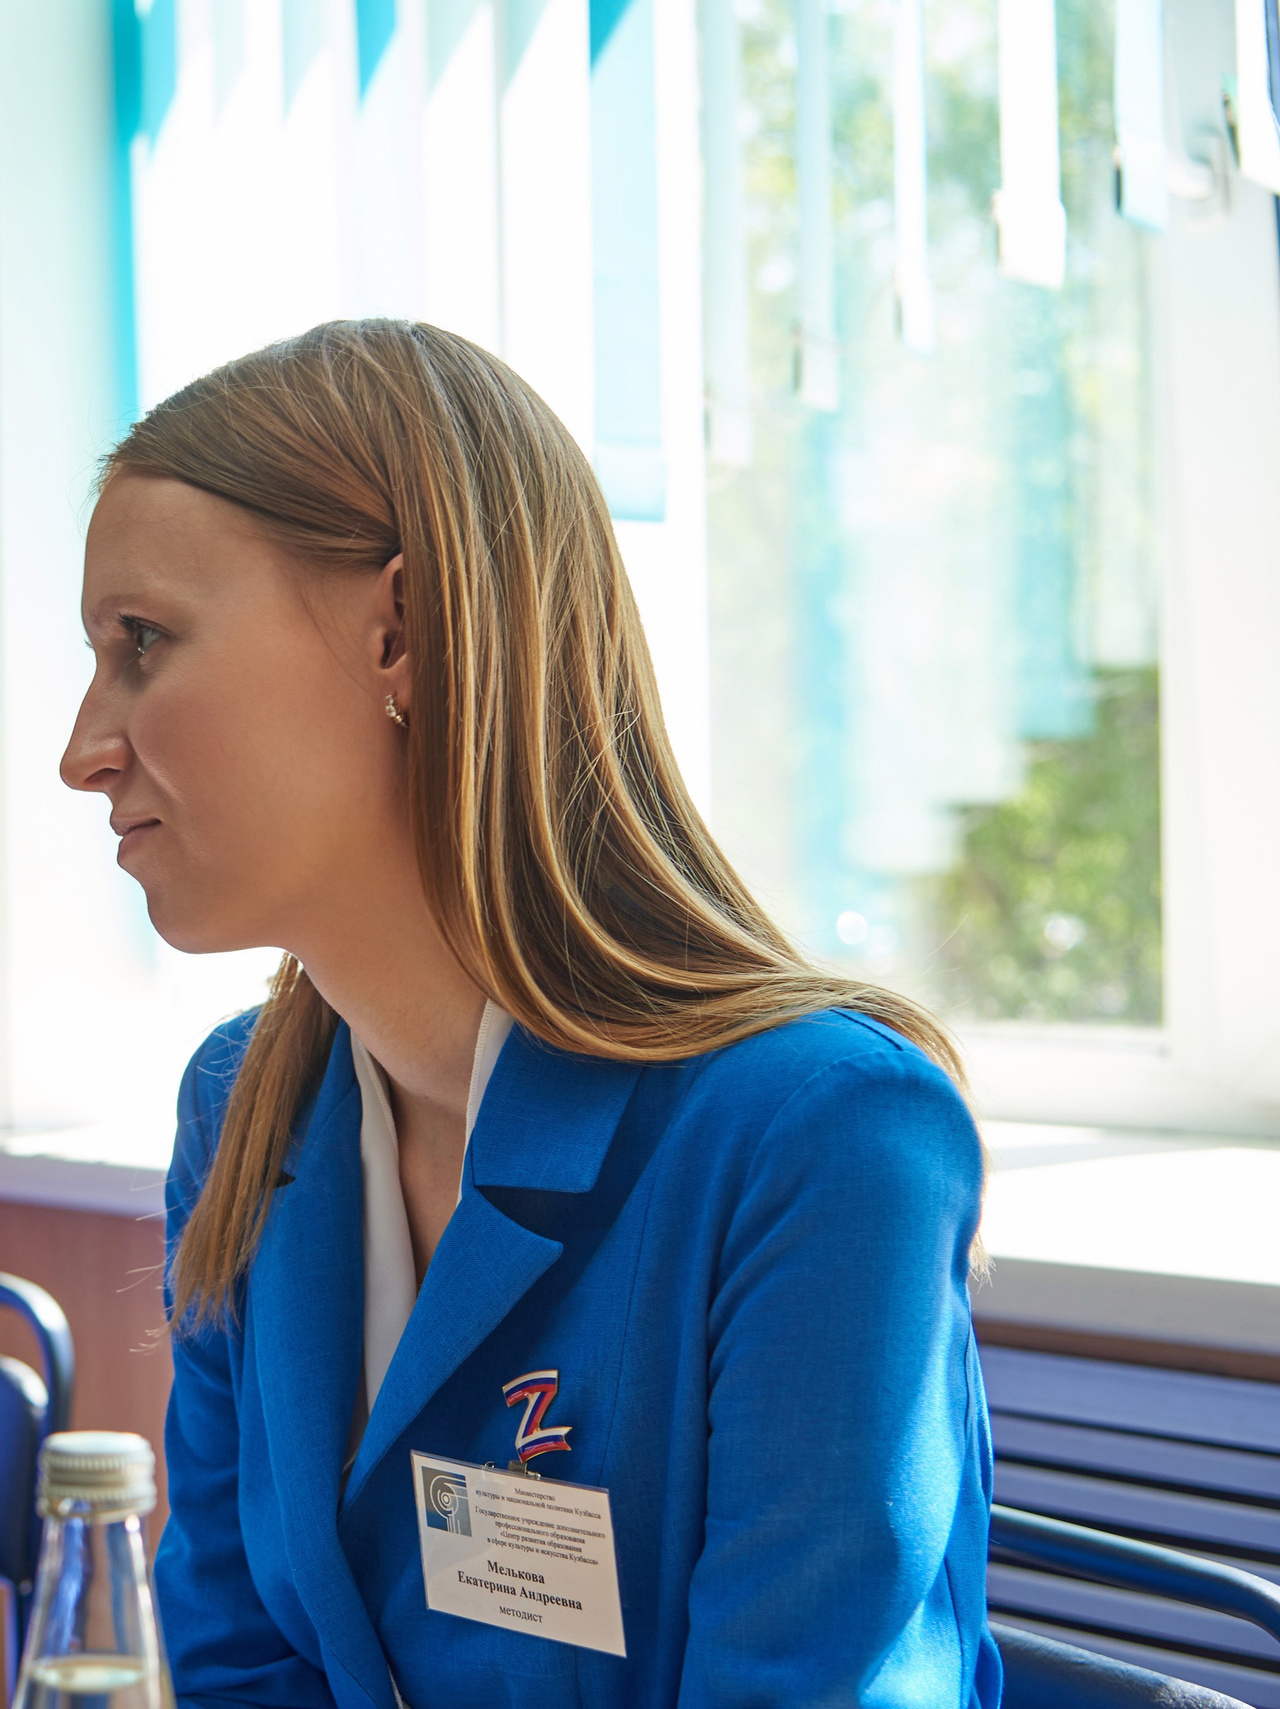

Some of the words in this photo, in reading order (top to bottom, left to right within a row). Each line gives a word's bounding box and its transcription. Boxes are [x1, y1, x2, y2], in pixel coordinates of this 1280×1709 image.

[475, 1489, 500, 1501] культуры
[506, 1496, 546, 1509] национальной
[547, 1502, 574, 1515] политики
[574, 1508, 601, 1520] Кузбасса
[514, 1487, 556, 1502] Министерство
[475, 1506, 521, 1522] Государственное
[521, 1517, 555, 1529] учреждение
[556, 1524, 606, 1539] дополнительного
[495, 1521, 549, 1537] профессионального
[550, 1531, 586, 1544] образования
[491, 1538, 508, 1547] сфере
[508, 1542, 535, 1553] культуры
[540, 1549, 569, 1560] искусства
[521, 1535, 546, 1546] развития
[547, 1540, 582, 1553] образования
[487, 1559, 545, 1584] Мелькова
[457, 1570, 517, 1596] Екатерина
[519, 1586, 583, 1611] Андреевна
[499, 1605, 543, 1623] методист
